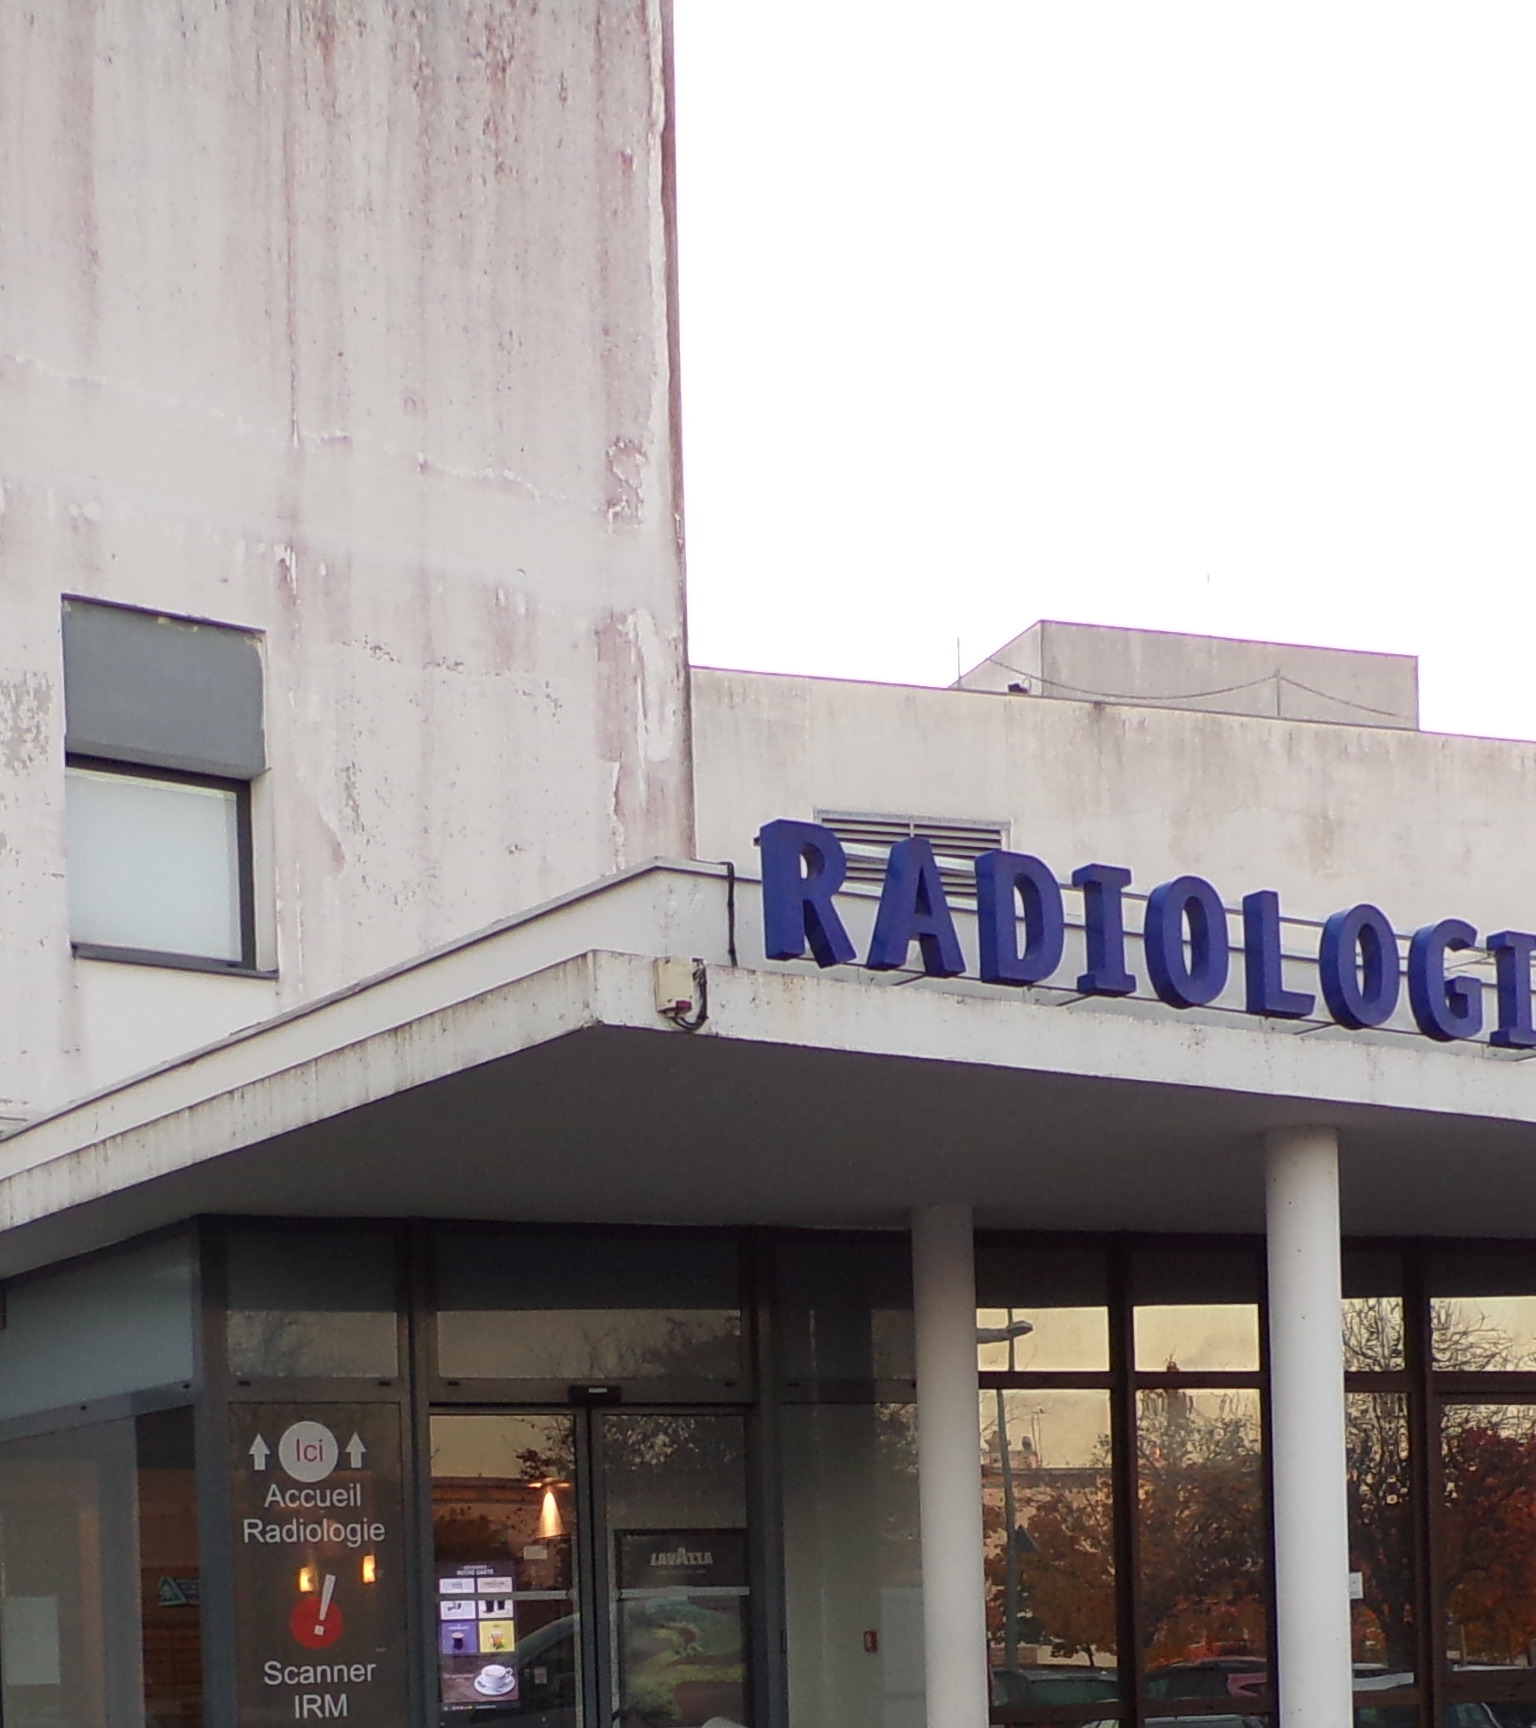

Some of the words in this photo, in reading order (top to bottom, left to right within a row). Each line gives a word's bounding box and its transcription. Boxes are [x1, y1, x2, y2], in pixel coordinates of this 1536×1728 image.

[296, 1438, 324, 1463] Ici
[264, 1482, 362, 1508] Accueil
[243, 1517, 386, 1548] Radiologie
[650, 1547, 714, 1567] LAVAZZA
[264, 1660, 377, 1686] Scanner
[294, 1693, 348, 1719] IRM
